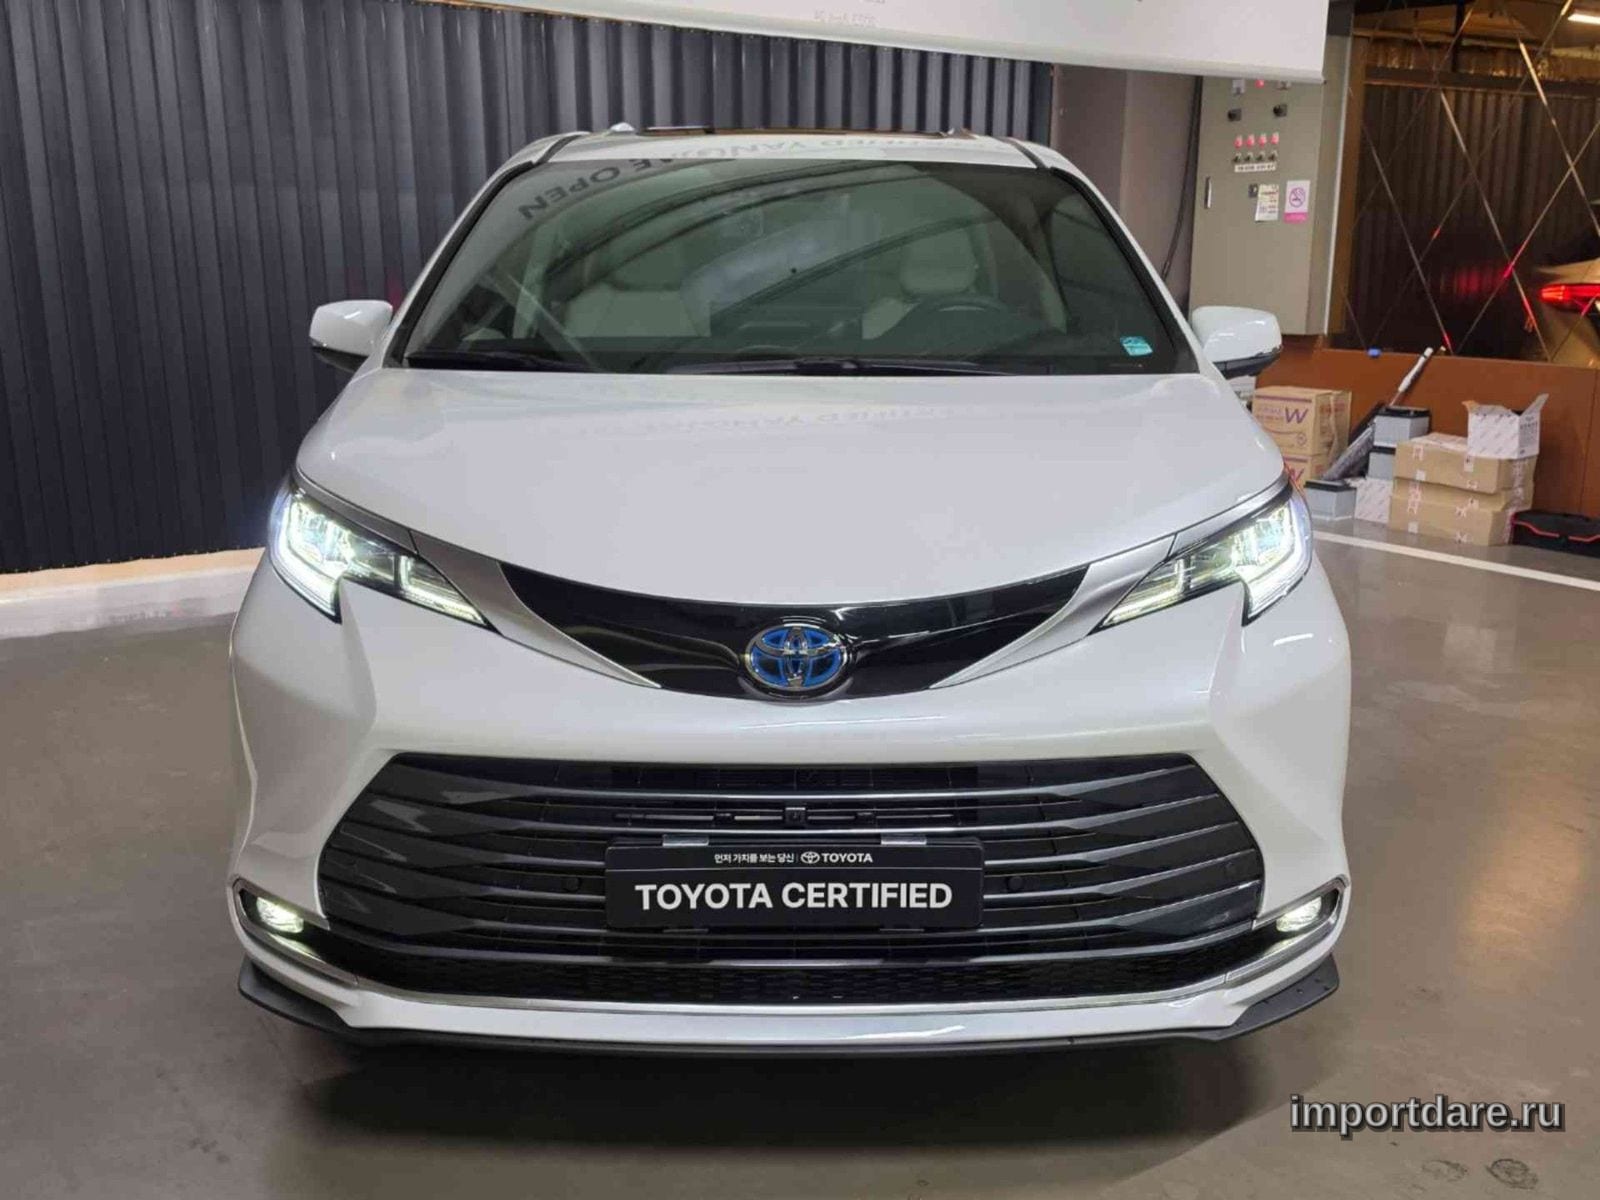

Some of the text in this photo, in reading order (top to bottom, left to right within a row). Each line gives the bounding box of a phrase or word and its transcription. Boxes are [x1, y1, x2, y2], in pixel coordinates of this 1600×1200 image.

[517, 166, 621, 220] OPEN
[714, 852, 795, 864] 먼저 가치를 보는 당신
[821, 852, 874, 864] TOYOTA
[634, 882, 953, 911] TOYOTA CERTIFIED
